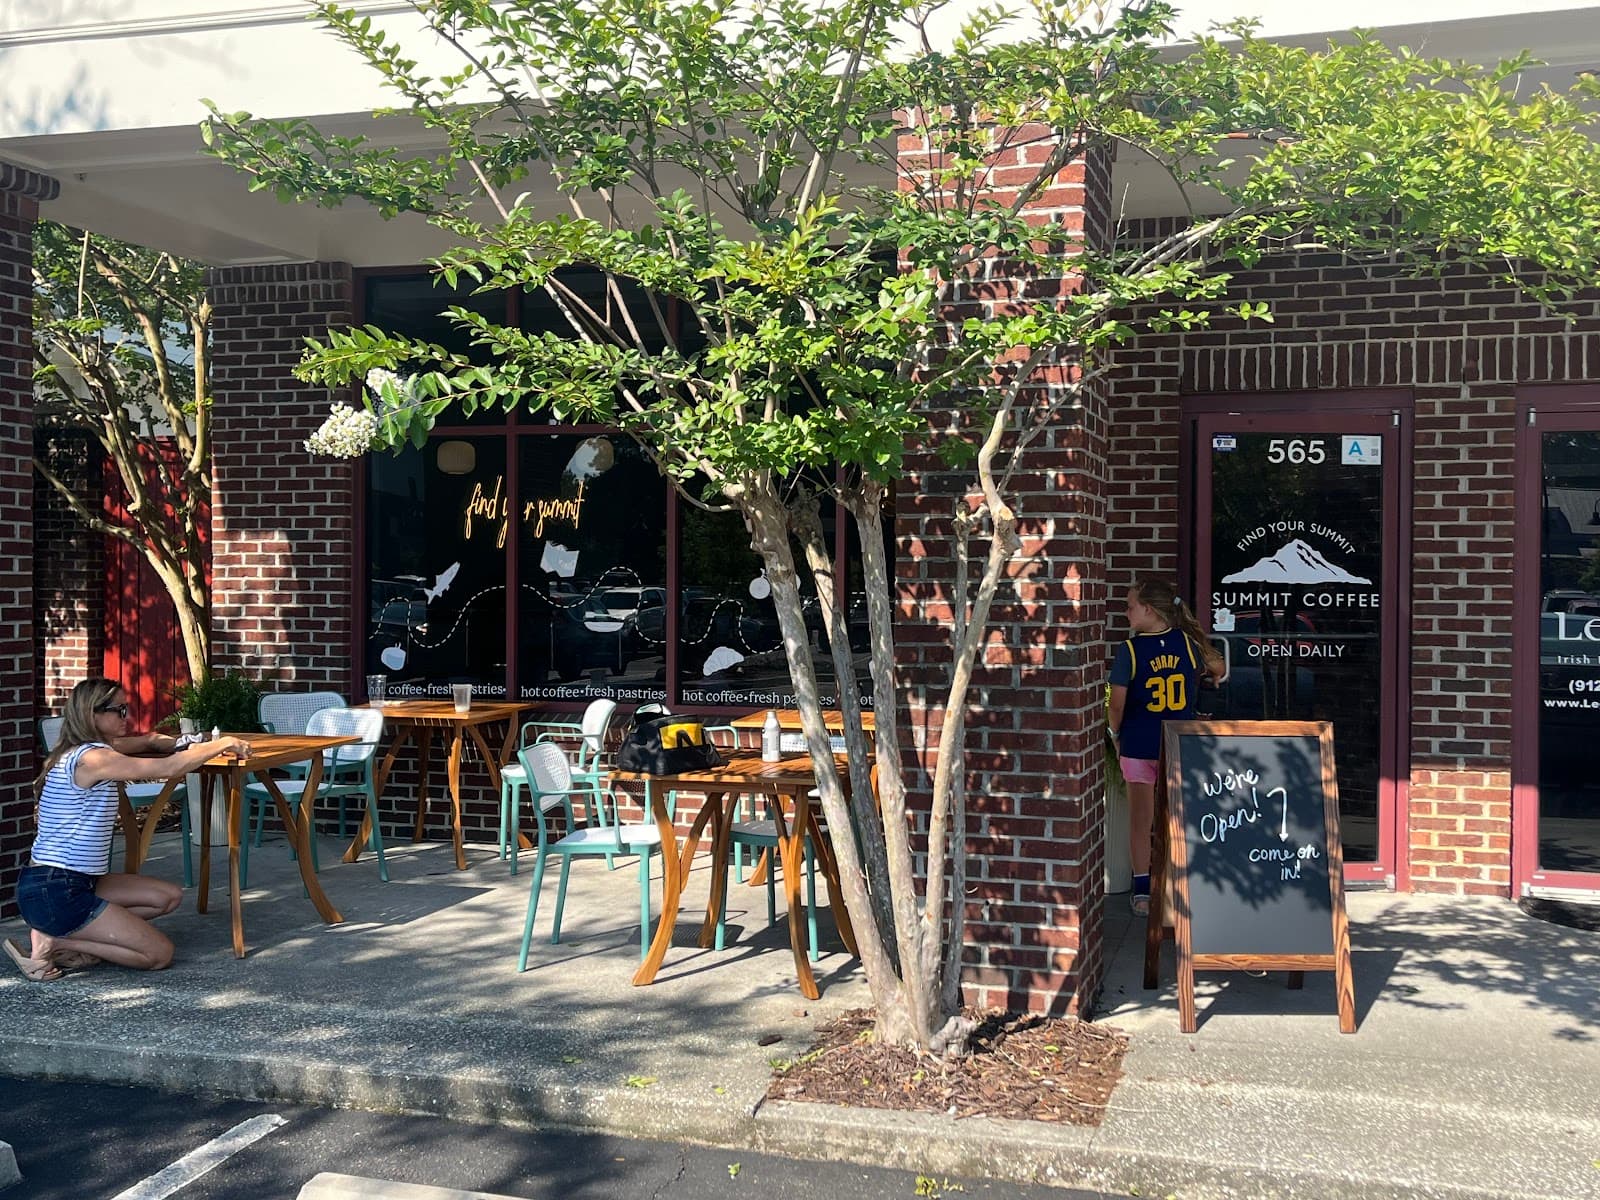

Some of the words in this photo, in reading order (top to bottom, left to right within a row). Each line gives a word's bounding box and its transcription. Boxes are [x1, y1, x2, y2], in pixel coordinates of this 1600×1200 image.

[1267, 439, 1326, 464] 565
[1348, 441, 1363, 456] A
[465, 475, 502, 540] find
[534, 479, 585, 538] summit
[1237, 527, 1266, 551] FIND
[1268, 521, 1305, 533] YOUR
[1310, 523, 1356, 555] SUMMIT
[1212, 592, 1292, 606] SUMMIT
[1303, 593, 1380, 607] COFFEE
[1247, 645, 1292, 657] OPEN
[1300, 645, 1345, 657] DAILY
[1150, 654, 1180, 672] CURRY
[1557, 655, 1590, 664] Irish
[388, 684, 423, 695] coffee
[521, 686, 540, 698] hot
[542, 686, 580, 698] coffee
[584, 685, 615, 698] fresh
[617, 688, 665, 700] pastries
[682, 689, 703, 702] hot
[706, 690, 744, 703] coffee
[749, 691, 780, 704] fresh
[1145, 673, 1187, 712] 30
[1249, 849, 1295, 862] come
[1297, 844, 1320, 859] on
